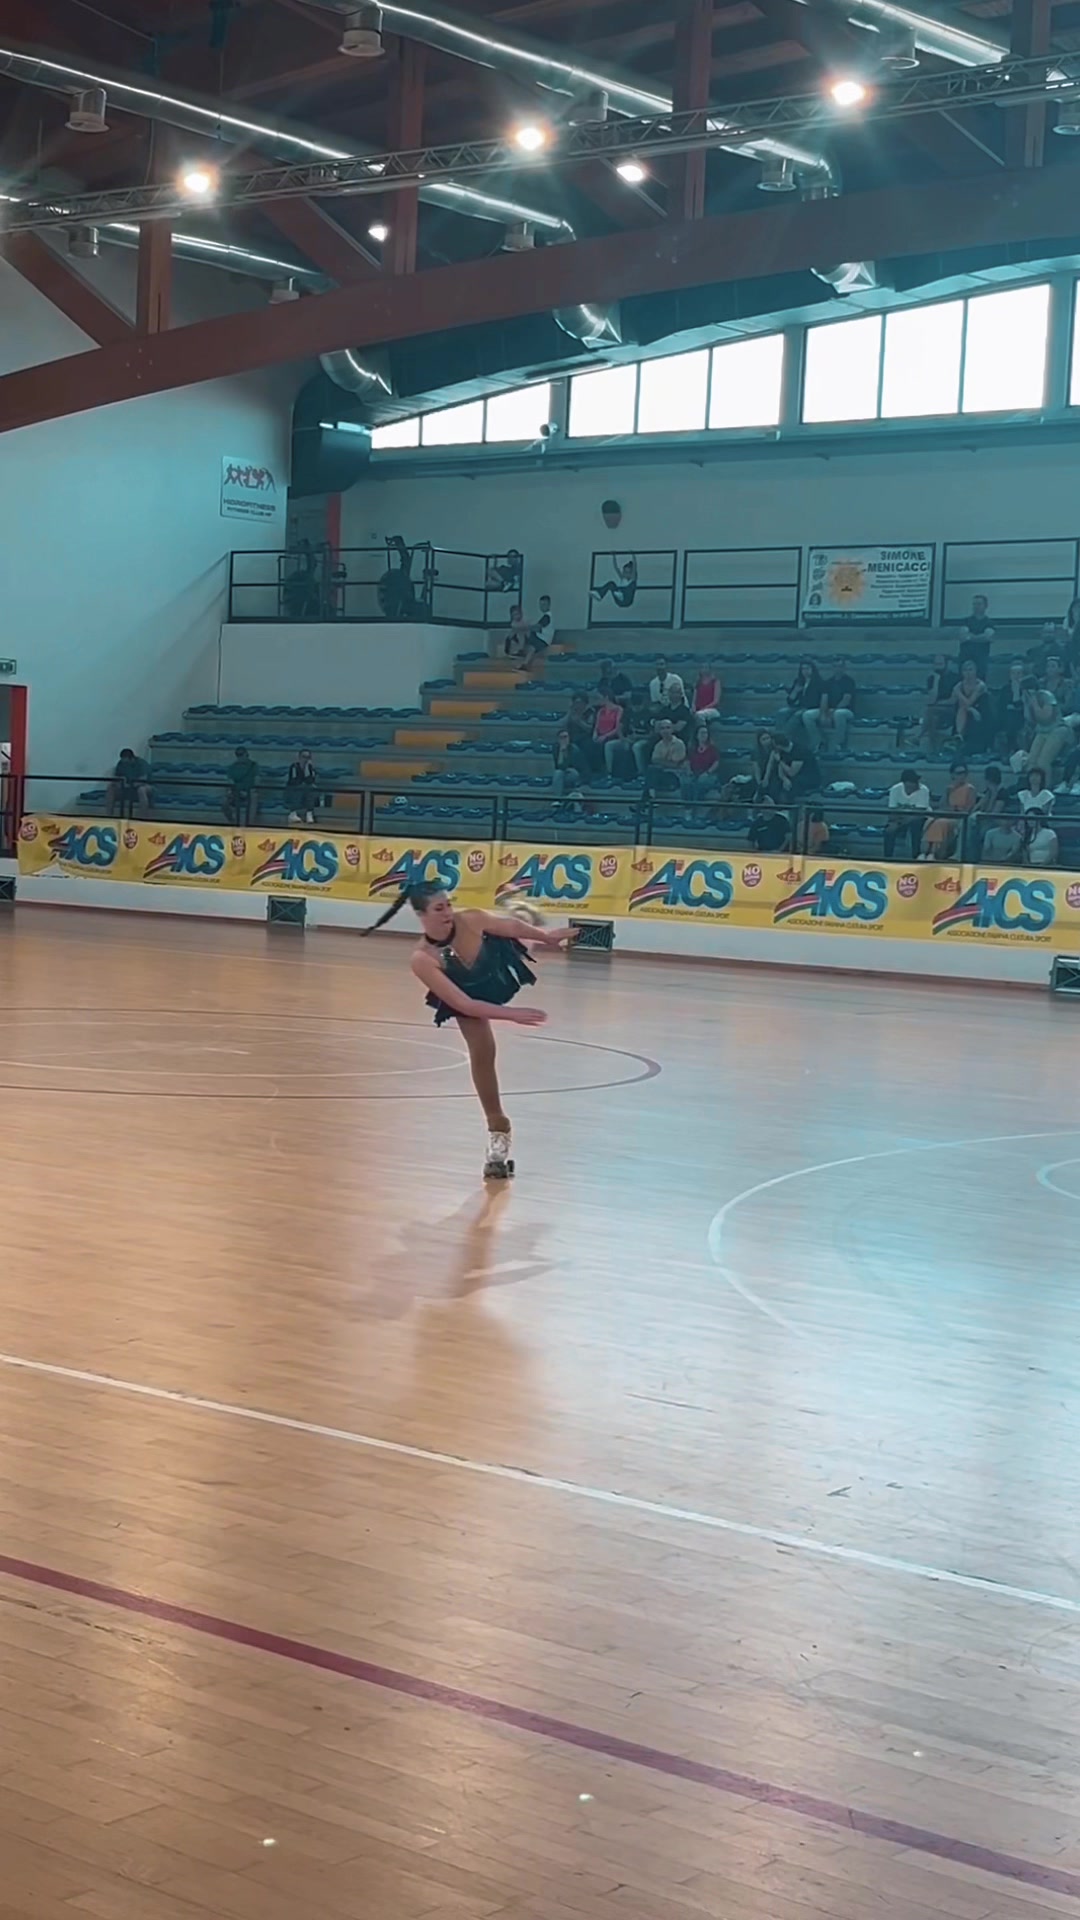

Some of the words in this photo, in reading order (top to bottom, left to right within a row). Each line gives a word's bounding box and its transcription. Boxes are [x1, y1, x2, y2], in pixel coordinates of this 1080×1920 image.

[880, 551, 926, 561] SIMONE
[601, 857, 616, 867] NO
[743, 866, 760, 877] NO
[898, 876, 917, 886] NO
